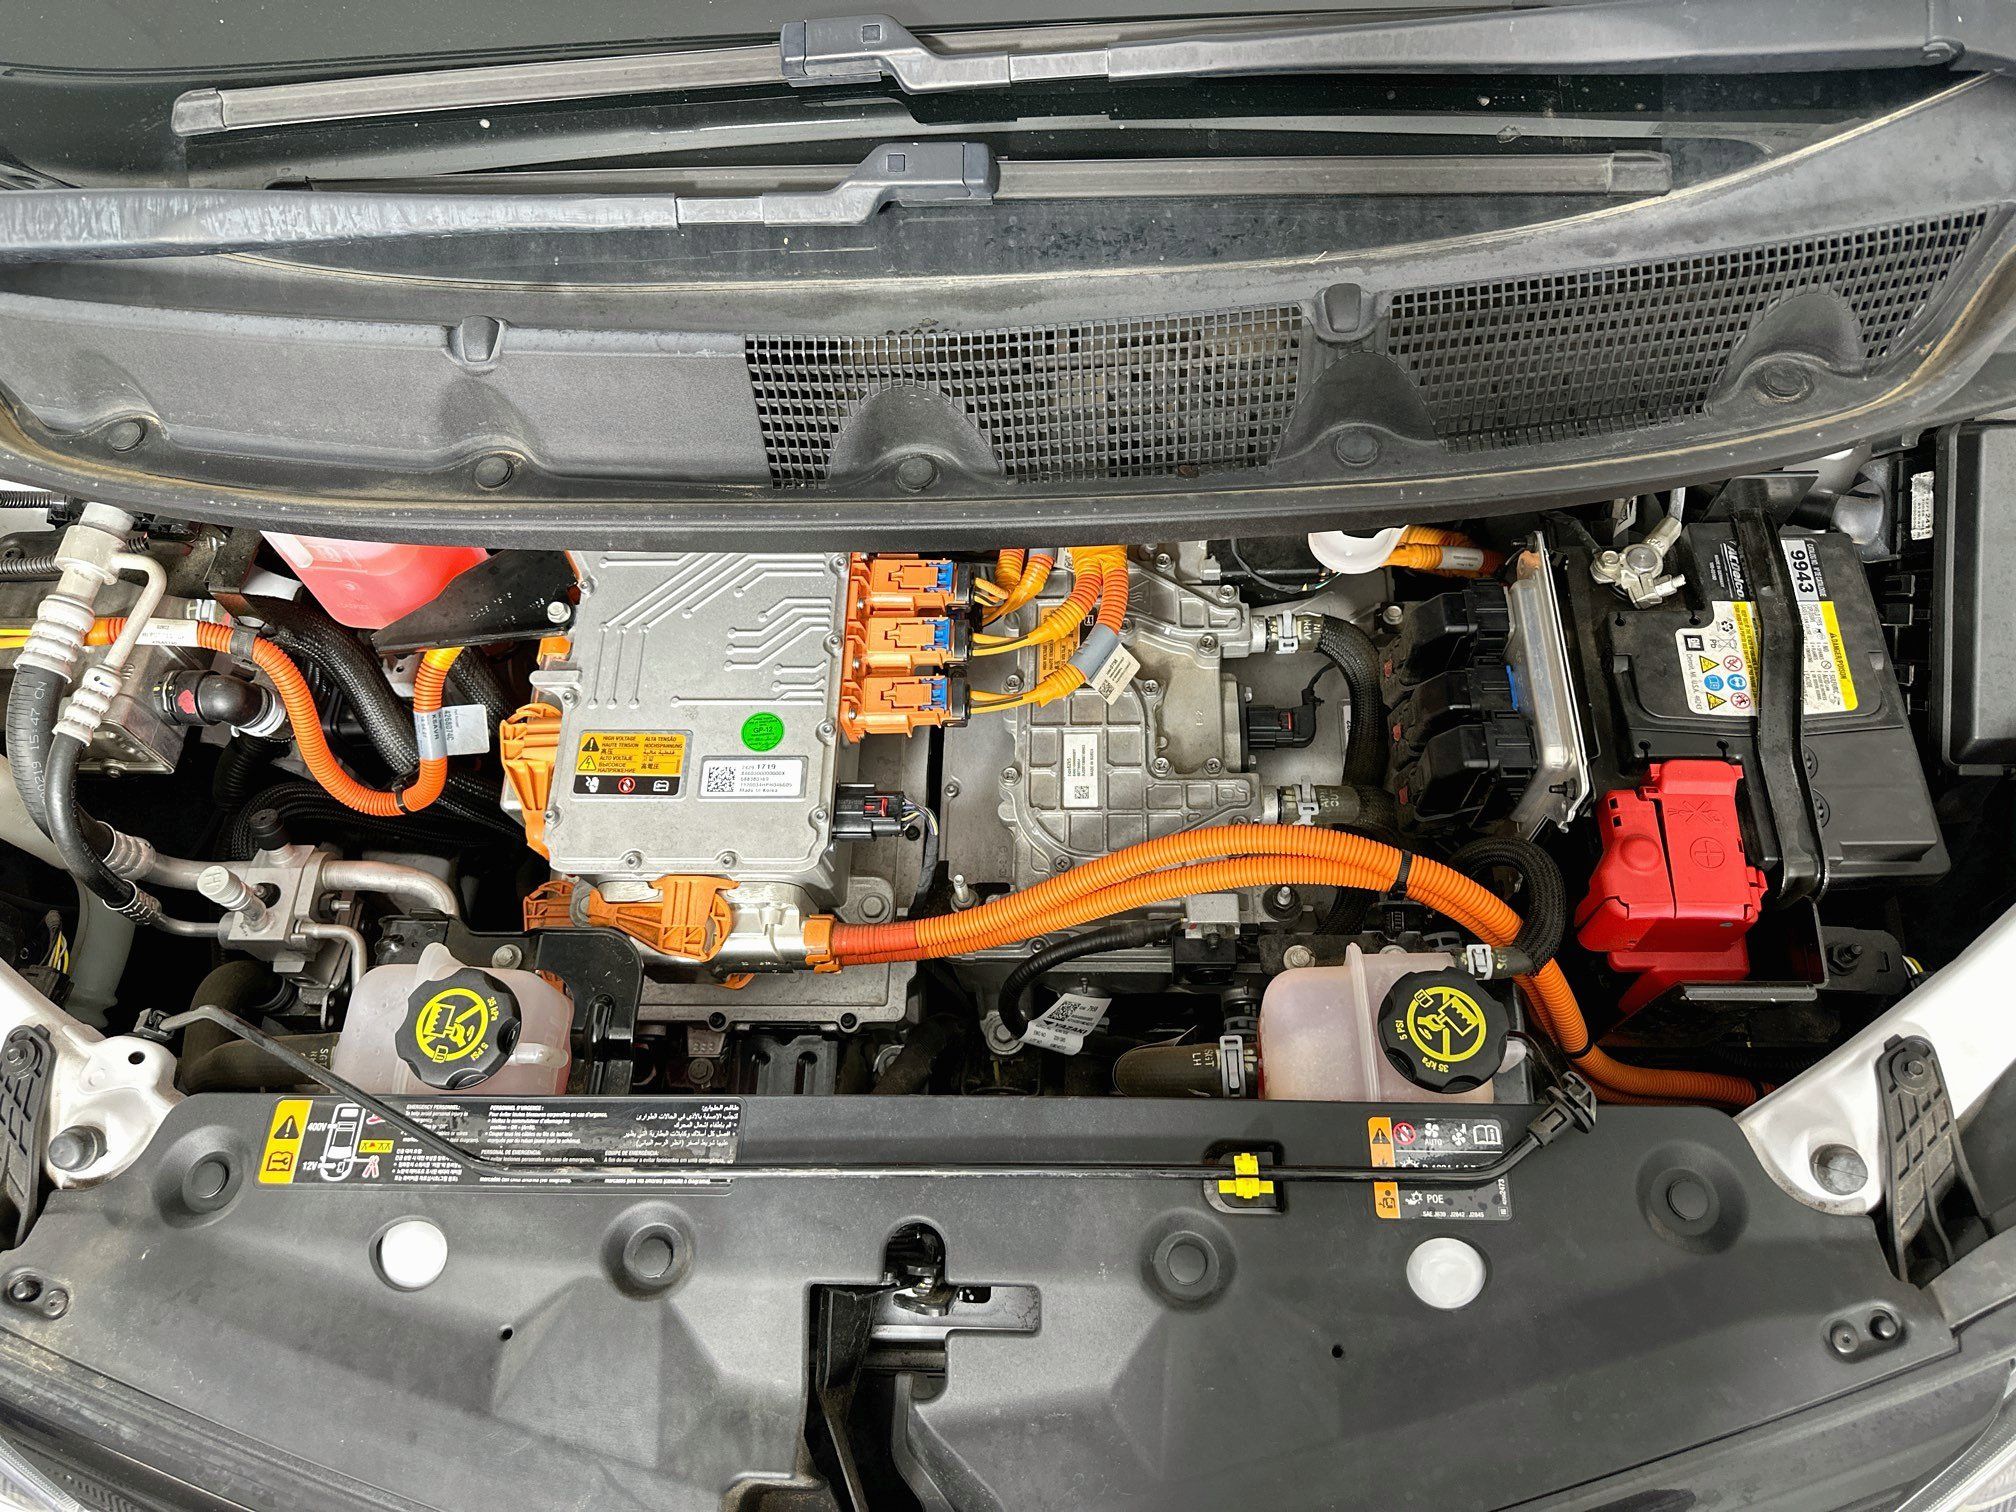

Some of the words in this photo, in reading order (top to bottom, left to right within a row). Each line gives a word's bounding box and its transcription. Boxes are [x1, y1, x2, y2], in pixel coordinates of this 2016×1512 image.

[1790, 550, 1814, 592] 9943
[1710, 639, 1718, 648] Pb
[30, 708, 41, 750] 15:47
[487, 996, 497, 1006] 35
[490, 1006, 500, 1021] kPa
[1055, 1022, 1088, 1034] YAZAKI
[1395, 1020, 1405, 1033] PSI
[481, 1042, 489, 1050] 5
[320, 1048, 328, 1066] SGT
[470, 1046, 484, 1061] PSI
[1192, 1052, 1202, 1066] LH
[1204, 1049, 1215, 1067] SGT
[1421, 1057, 1437, 1071] kPa
[1438, 1064, 1449, 1073] 35
[307, 1123, 328, 1131] 400V
[303, 1161, 318, 1170] 12V
[1426, 1194, 1444, 1204] POE
